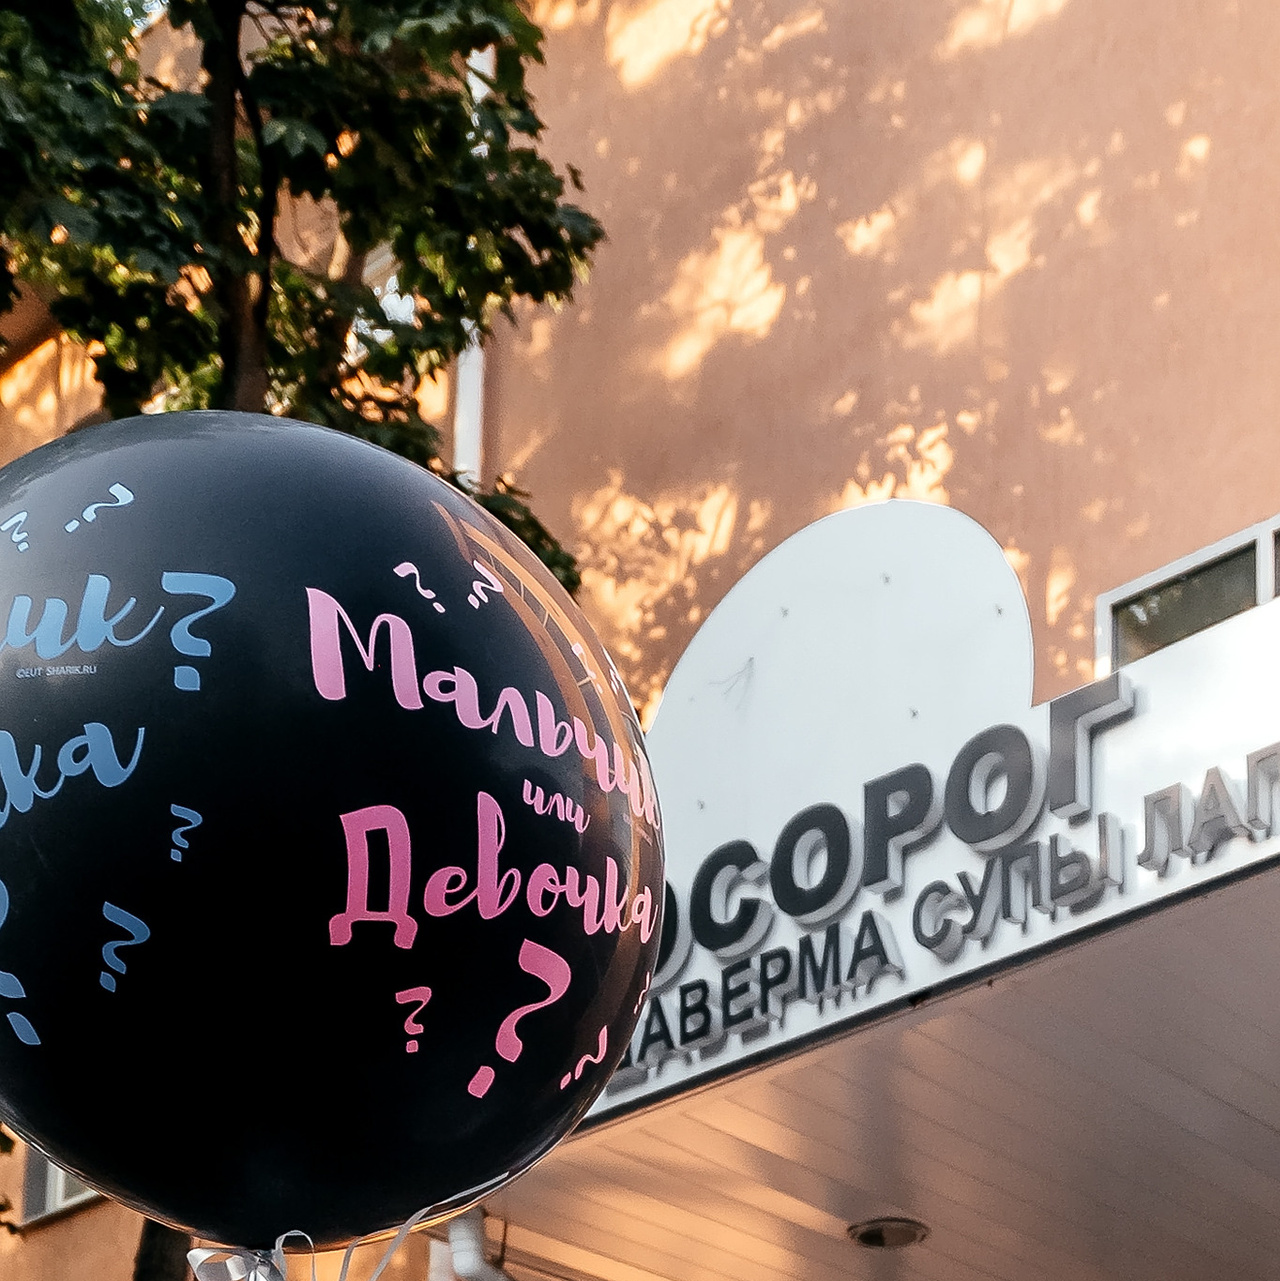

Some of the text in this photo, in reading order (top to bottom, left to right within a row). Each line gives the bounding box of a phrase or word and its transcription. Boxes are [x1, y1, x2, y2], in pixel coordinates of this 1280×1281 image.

[329, 791, 659, 950] Девочка
[522, 777, 592, 834] или
[656, 672, 1128, 978] СОРОГ
[622, 908, 896, 1072] АВЕРМА
[911, 811, 1116, 953] СУПЫ
